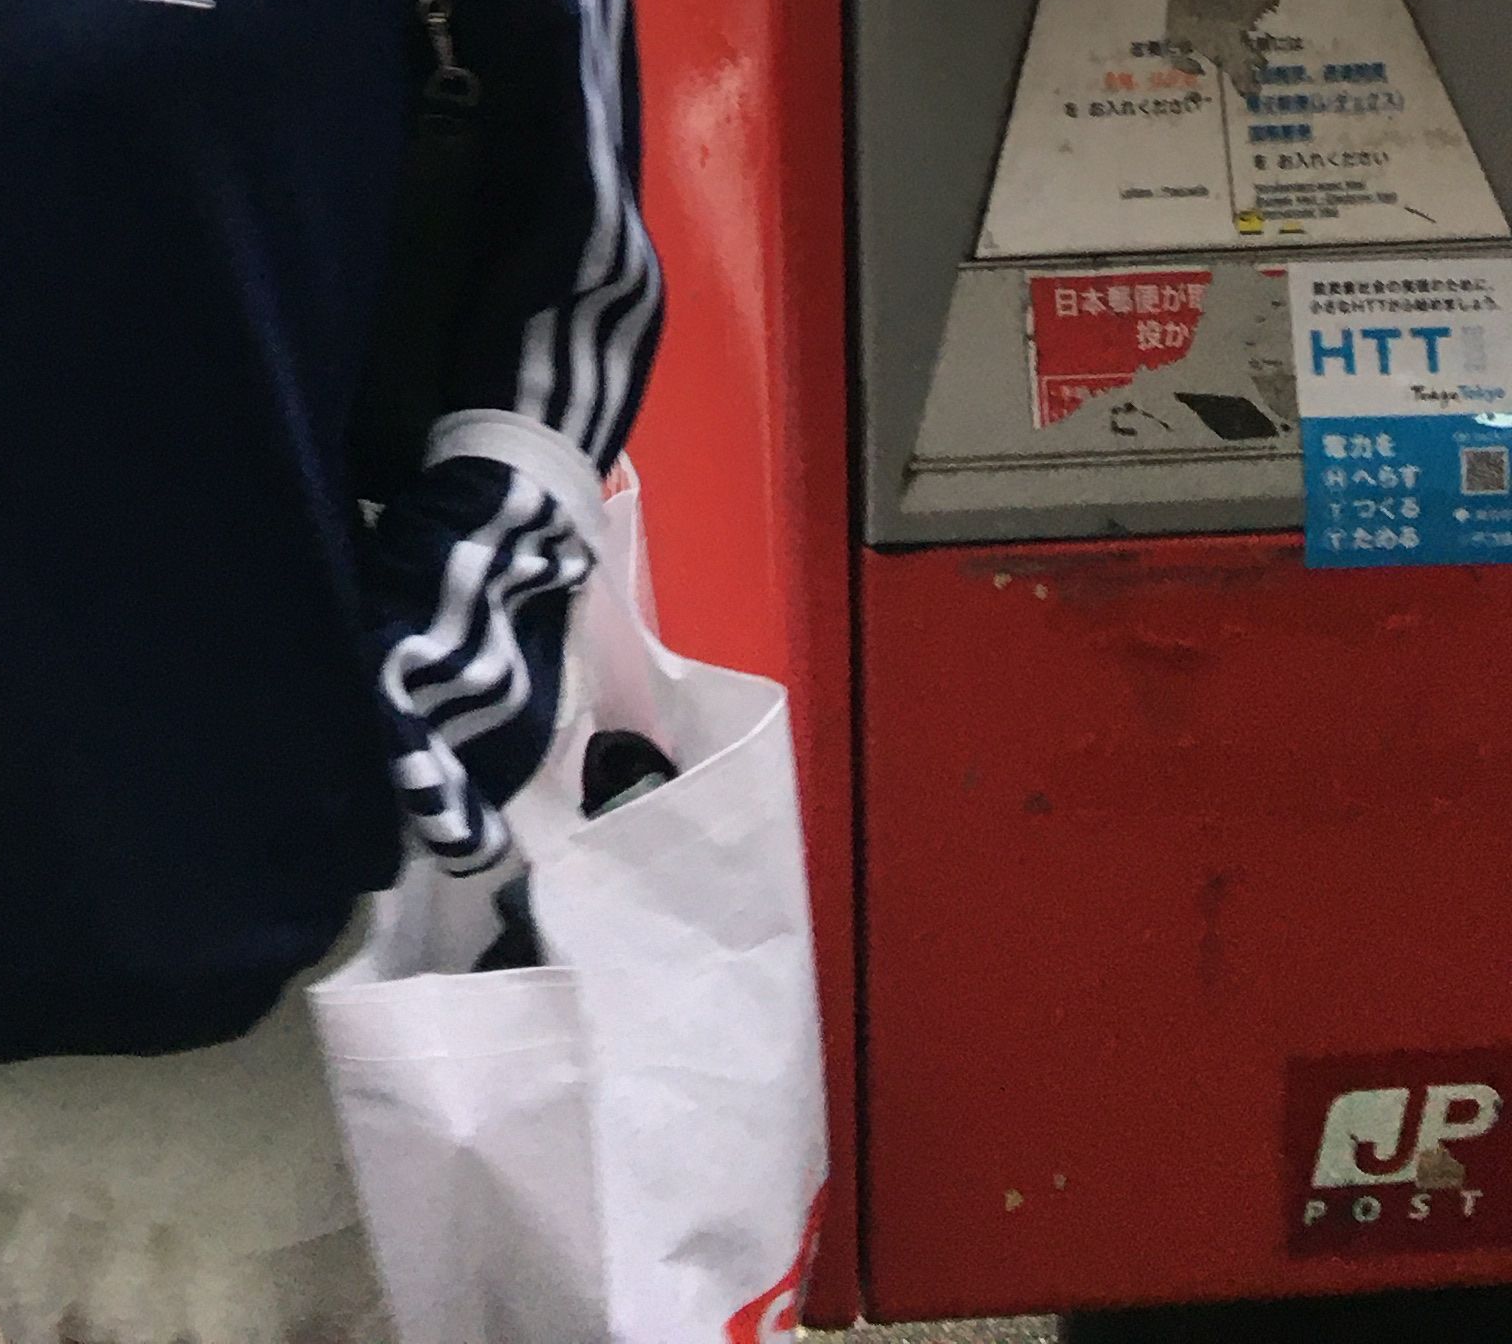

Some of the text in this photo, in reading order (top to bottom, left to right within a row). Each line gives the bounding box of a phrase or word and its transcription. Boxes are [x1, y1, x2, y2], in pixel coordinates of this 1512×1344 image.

[1310, 326, 1452, 376] HTT
[1311, 1083, 1504, 1190] JP
[1303, 1189, 1484, 1227] POST
